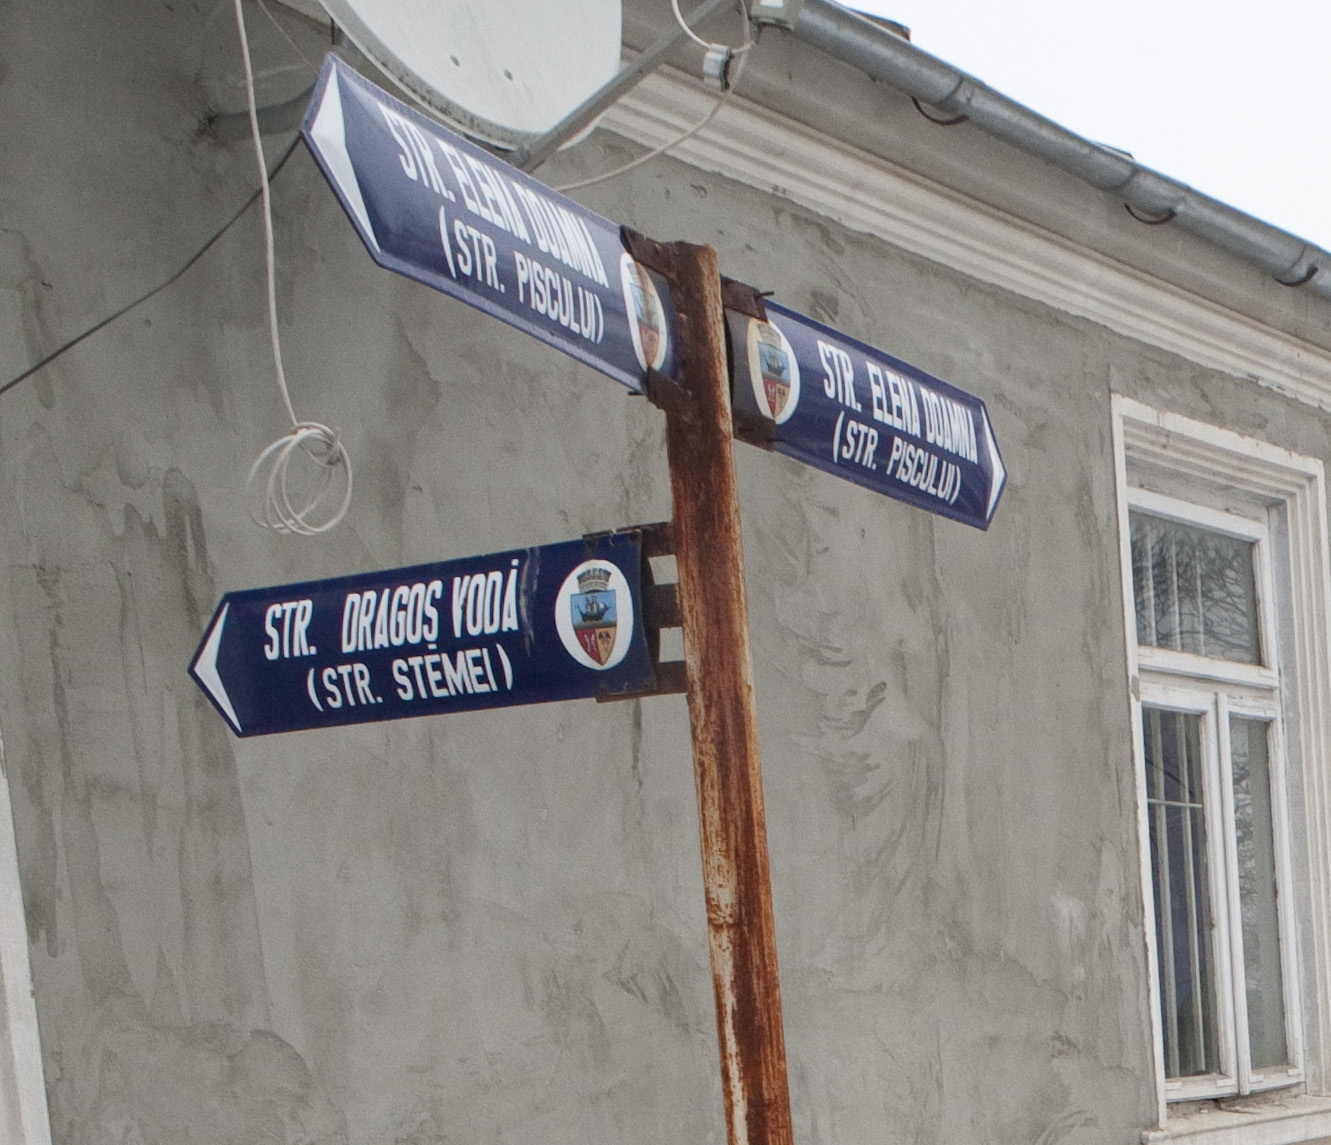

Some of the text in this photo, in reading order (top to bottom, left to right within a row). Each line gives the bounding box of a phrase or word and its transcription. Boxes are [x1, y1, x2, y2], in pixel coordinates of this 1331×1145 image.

[377, 102, 456, 203] STR.
[435, 137, 530, 245] ELENA
[439, 205, 604, 344] (STR. PISCULUI)
[817, 340, 978, 464] STR. ELENA DOAMNA
[833, 410, 961, 504] (STR. PISCULUI)
[264, 600, 317, 661] STR.
[307, 662, 383, 712] (STR.
